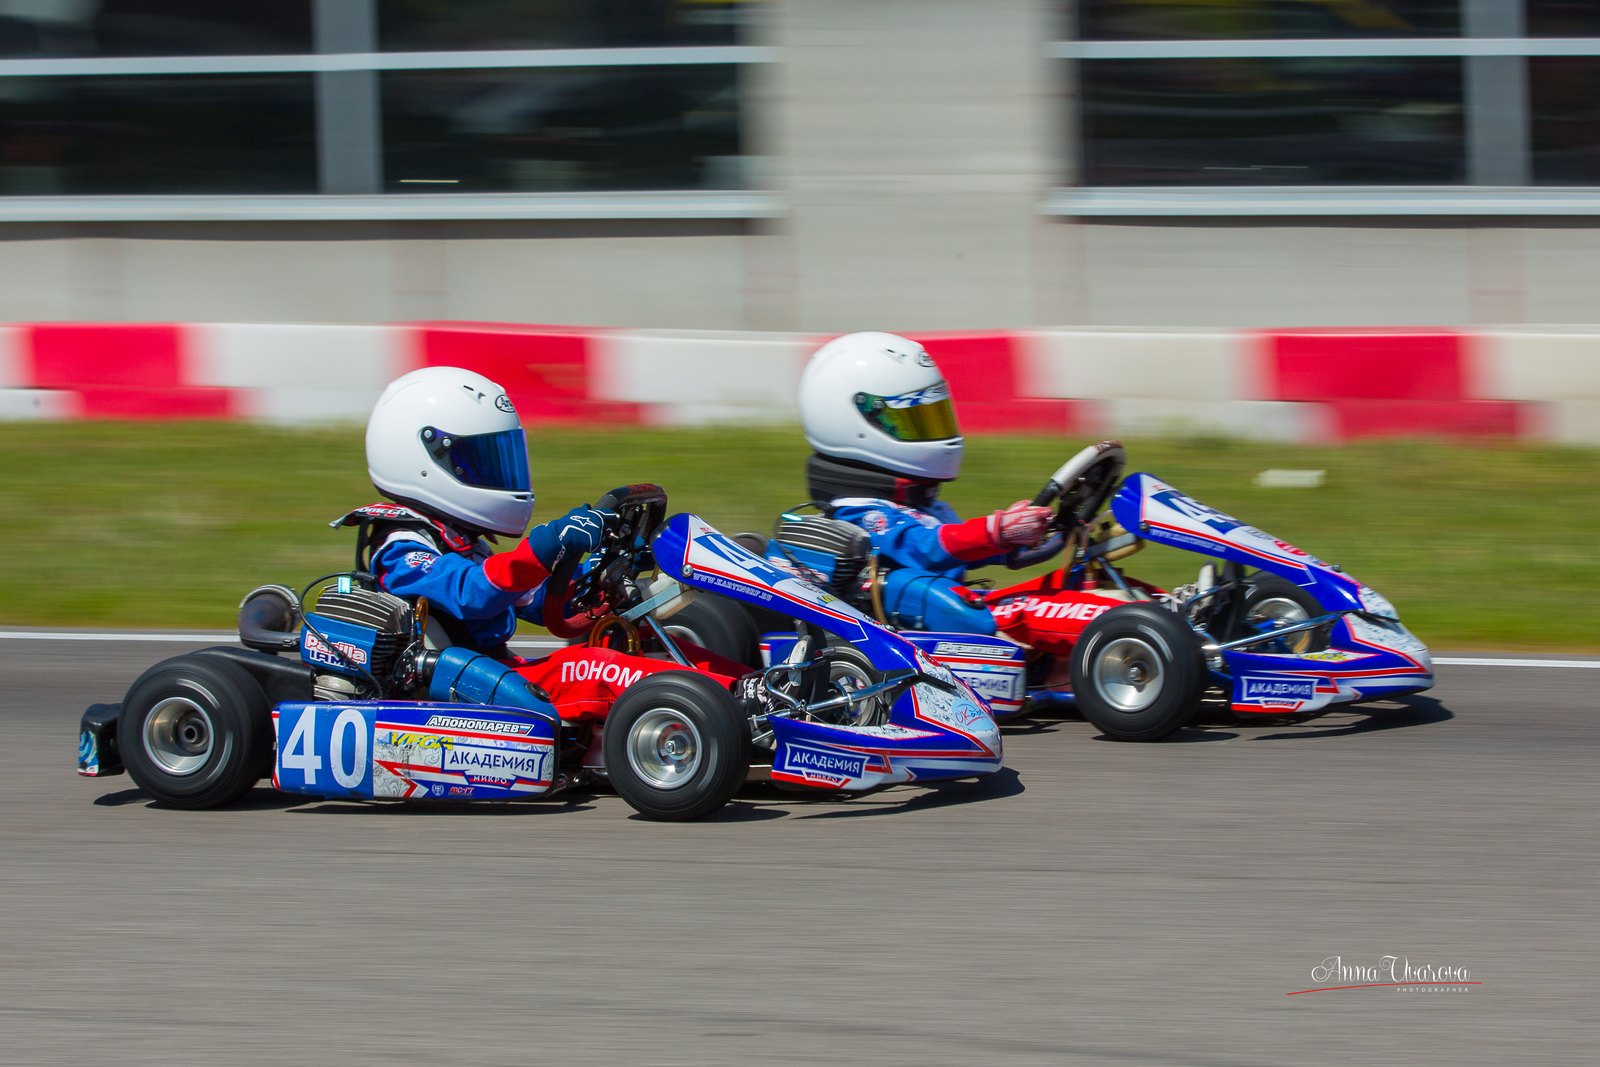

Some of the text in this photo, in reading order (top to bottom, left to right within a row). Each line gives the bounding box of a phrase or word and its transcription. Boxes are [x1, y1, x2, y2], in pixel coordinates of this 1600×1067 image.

[561, 660, 653, 688] ПОНОМ
[1248, 682, 1311, 695] АКАДЕМИЯ
[429, 716, 520, 734] А.ПОНОМАРЕВ
[282, 705, 368, 789] 40
[450, 750, 535, 773] АКАДЕМИЯ
[792, 751, 861, 773] АКАДЕМИЯ
[473, 775, 508, 785] МИКРО
